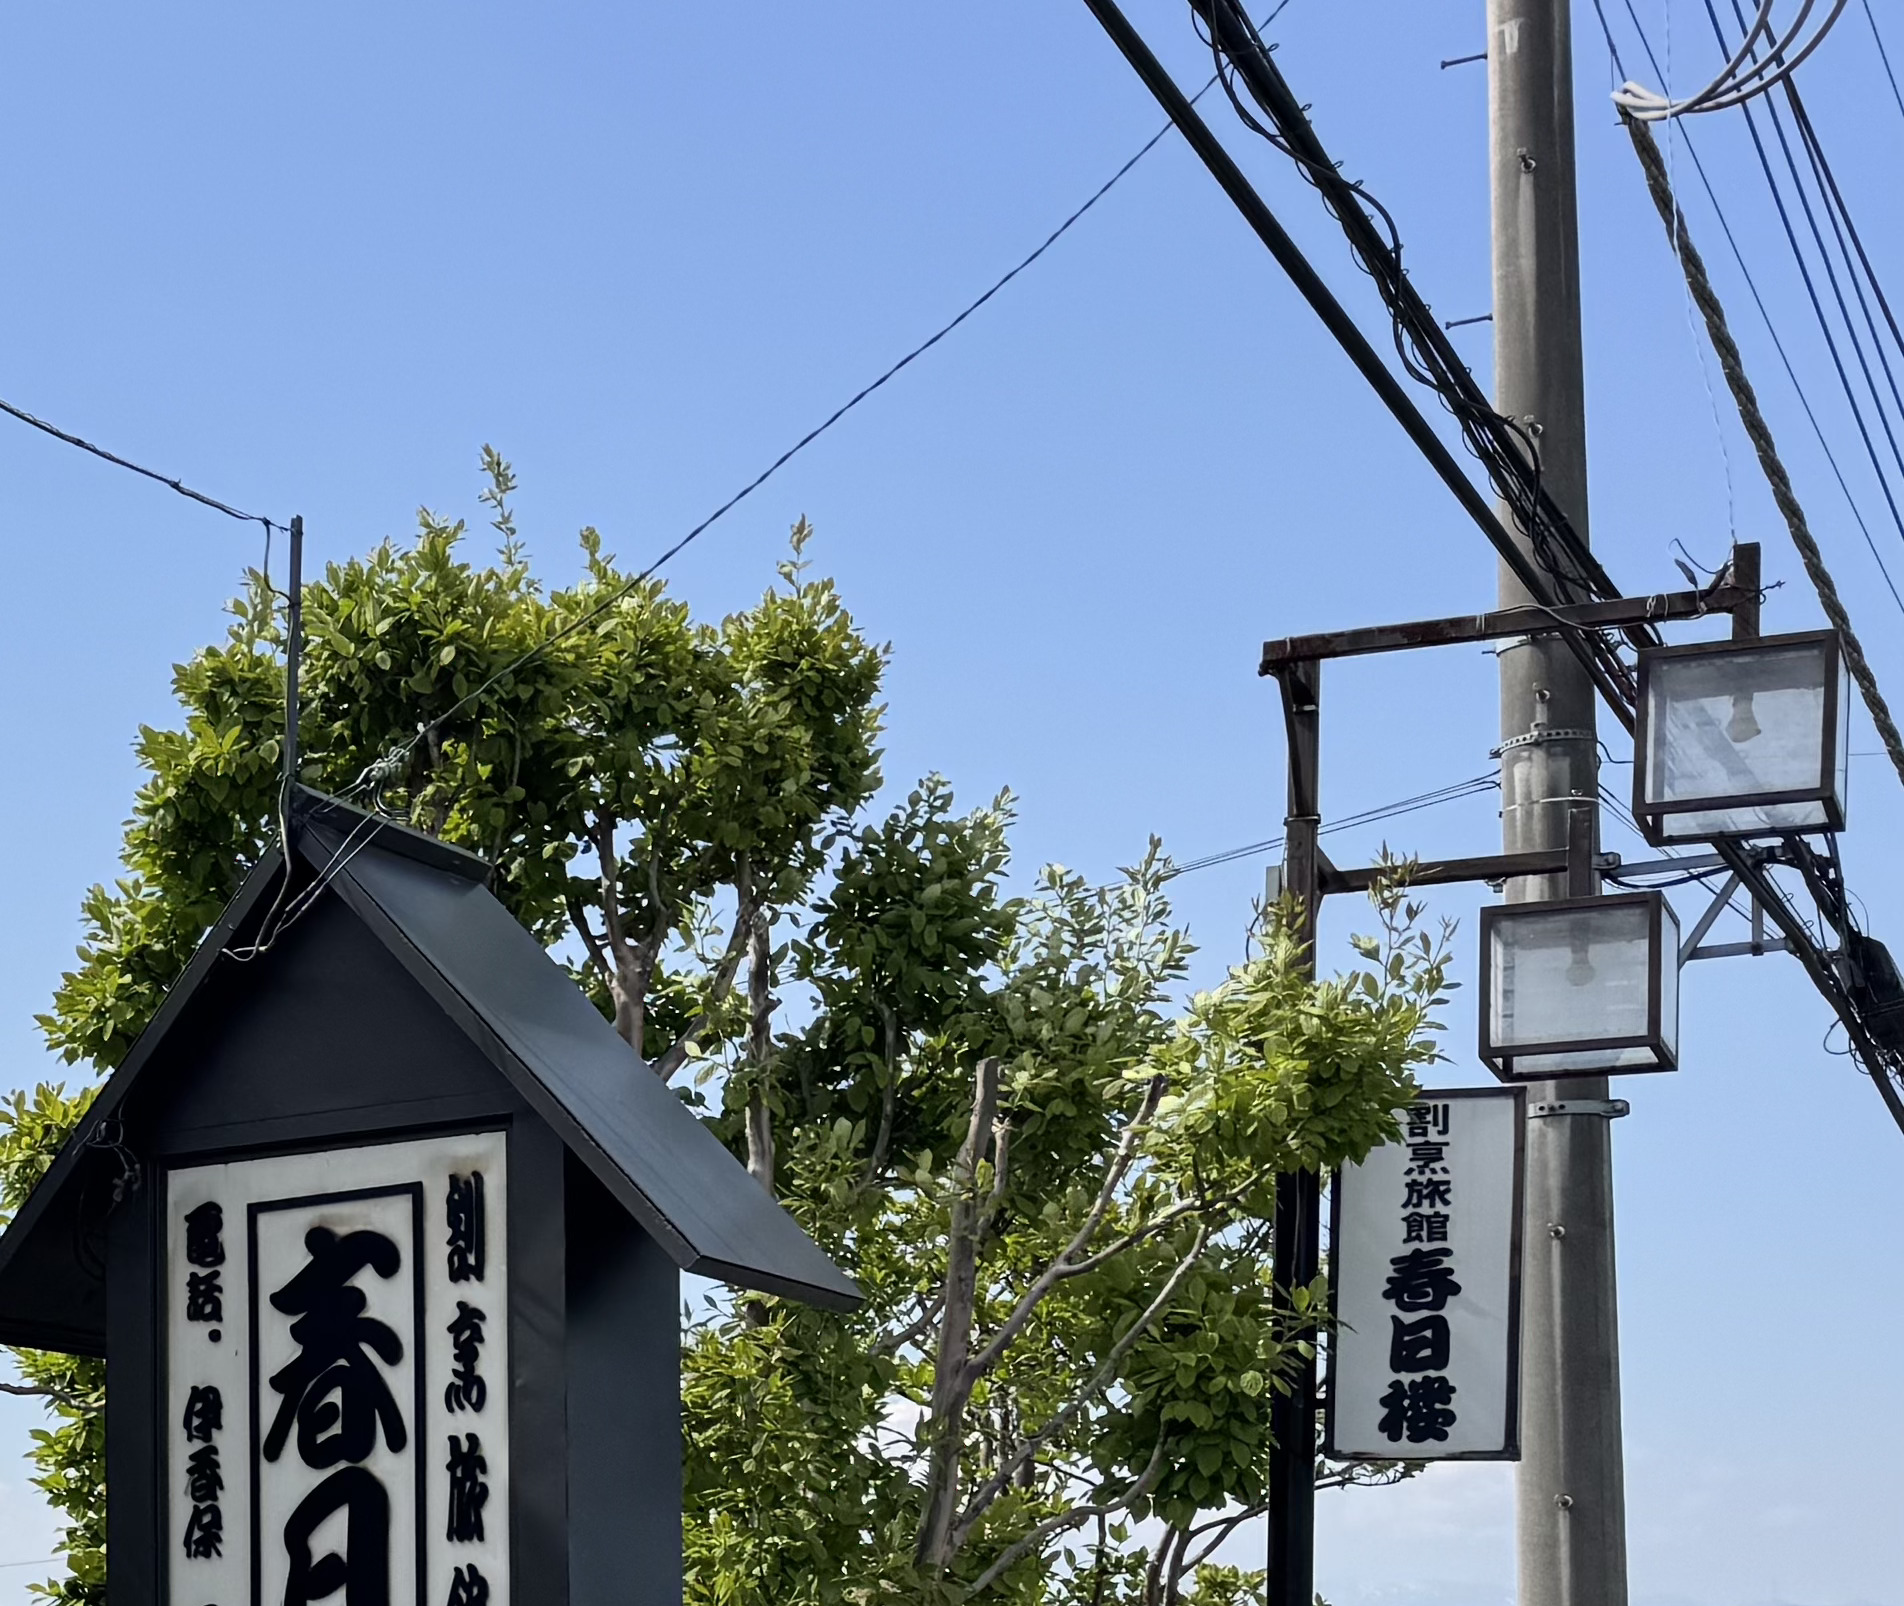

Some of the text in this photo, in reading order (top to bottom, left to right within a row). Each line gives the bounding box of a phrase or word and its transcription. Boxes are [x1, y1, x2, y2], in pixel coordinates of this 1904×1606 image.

[1400, 1102, 1453, 1245] 割烹旅館
[1377, 1247, 1462, 1443] 春日楼
[182, 1385, 225, 1560] 伊香保
